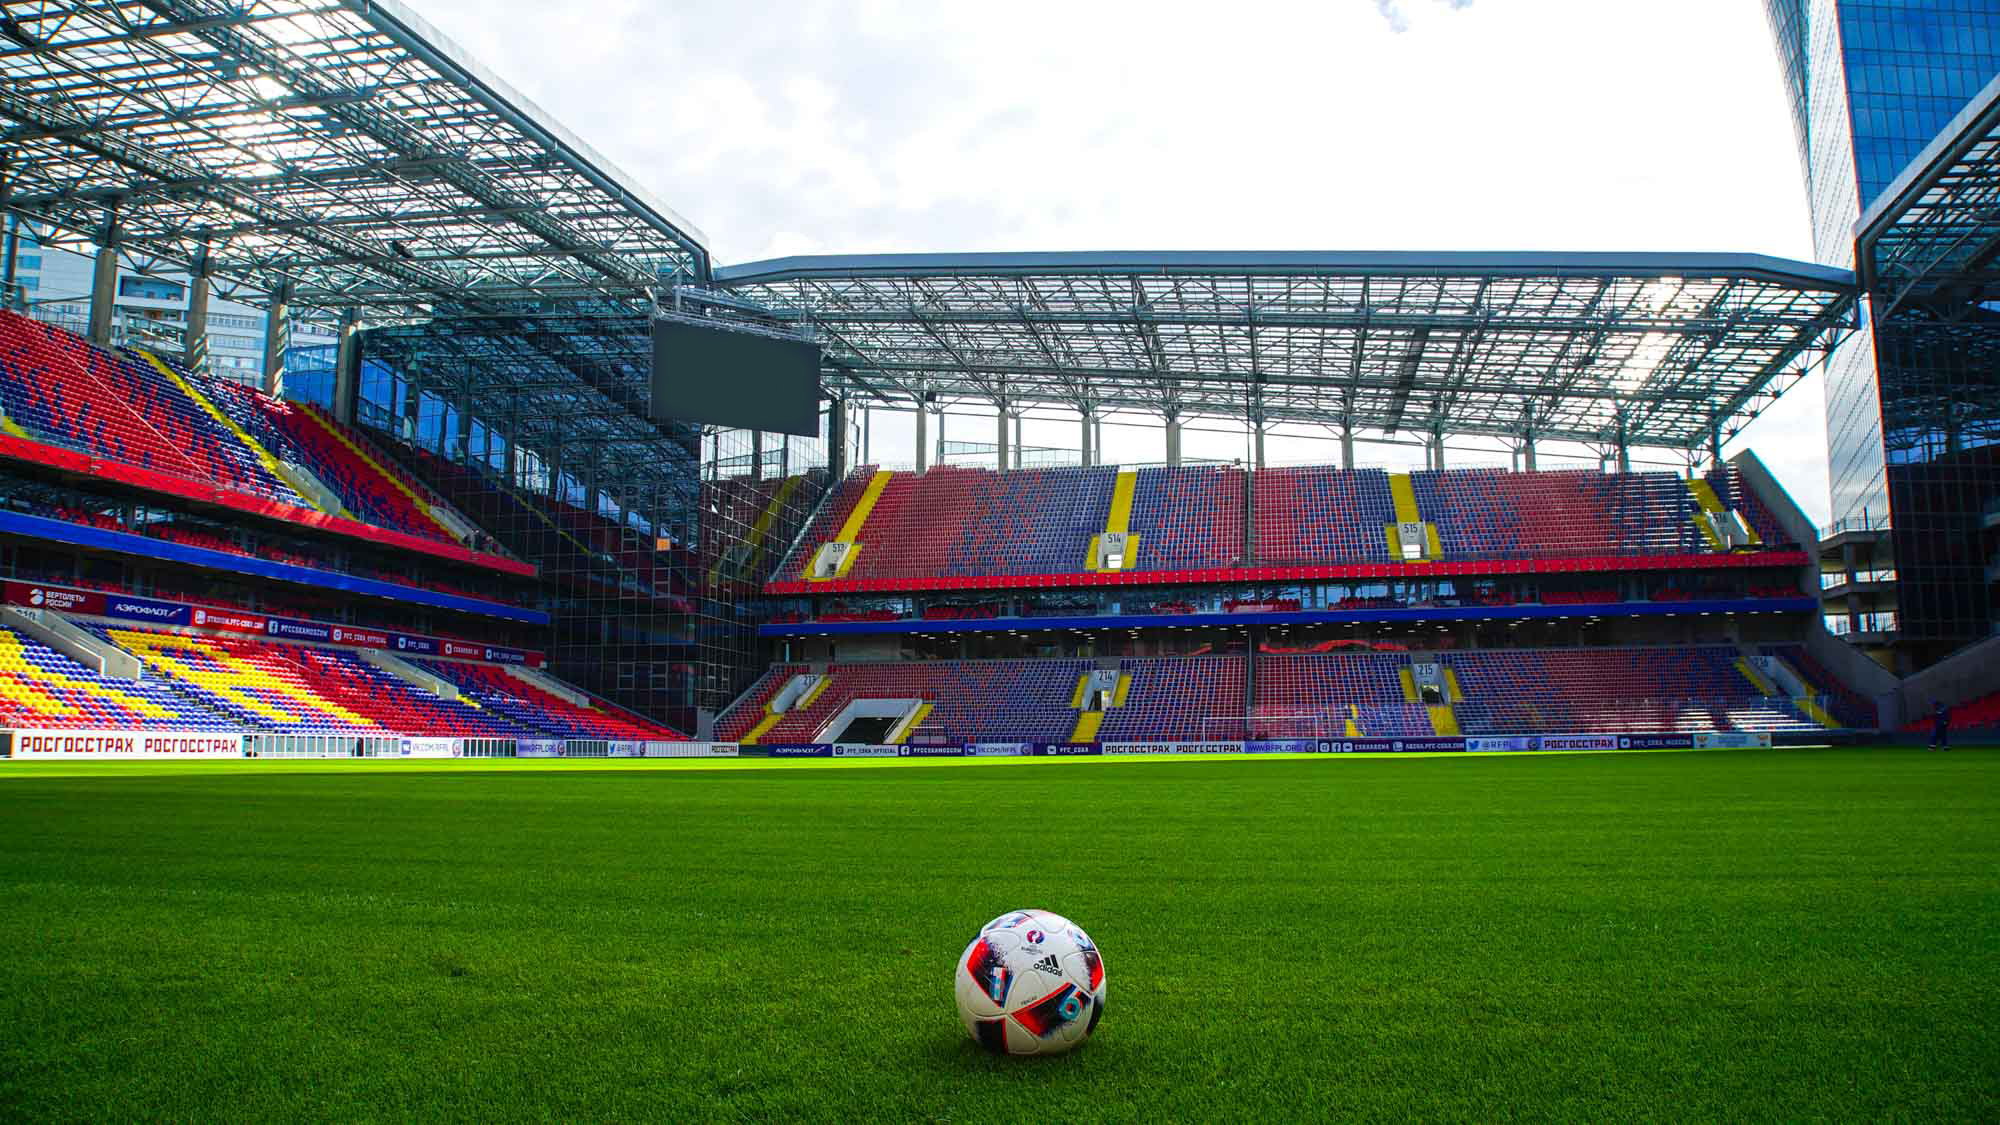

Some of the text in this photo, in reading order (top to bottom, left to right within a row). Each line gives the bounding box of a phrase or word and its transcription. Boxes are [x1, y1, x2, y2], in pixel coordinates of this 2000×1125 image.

[1107, 533, 1121, 544] 514
[46, 591, 85, 603] ВЕРТОЛЕТЫ
[115, 603, 168, 617] АЭРОФЛОТ
[21, 736, 237, 753] РОСГОССТРАХ РОСГОССТРАХ
[1105, 745, 1170, 754] РОСГОССТРАХ
[1544, 739, 1614, 749] РОСГОССТРАХ
[1033, 963, 1062, 977] adidas
